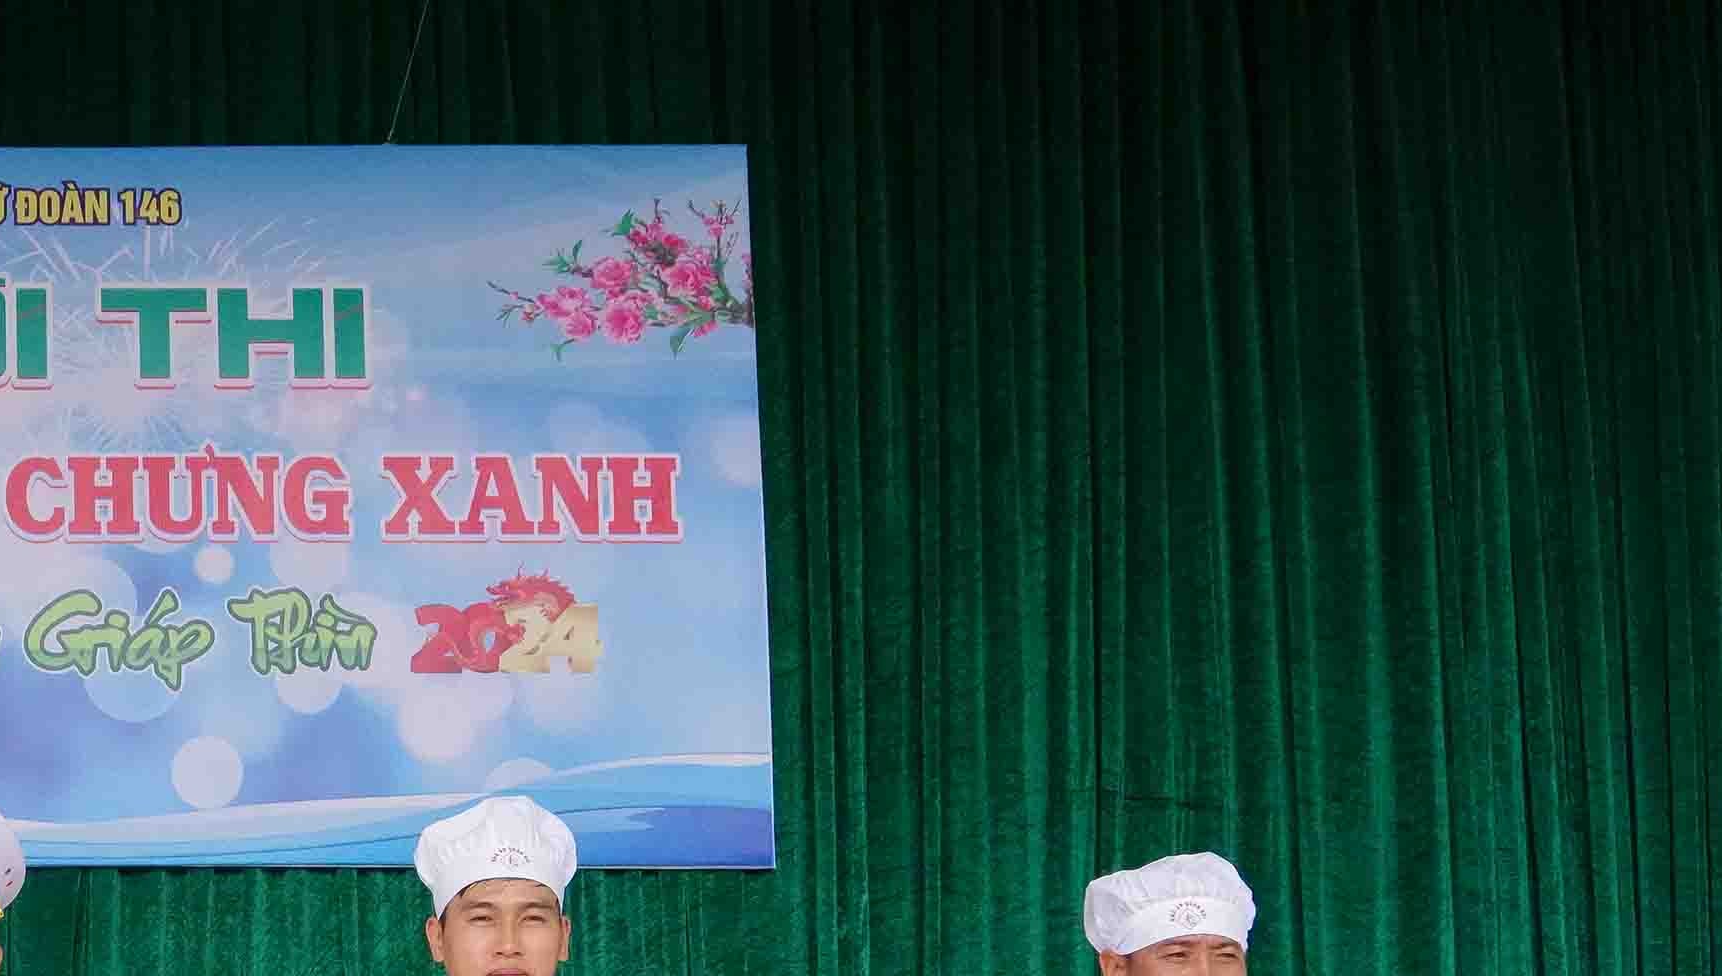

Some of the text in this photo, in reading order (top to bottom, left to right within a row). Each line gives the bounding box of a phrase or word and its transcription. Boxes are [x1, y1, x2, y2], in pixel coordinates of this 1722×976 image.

[14, 180, 110, 225] ĐOÀN
[118, 187, 182, 225] 146
[97, 286, 369, 387] THI
[5, 442, 350, 540] CHƯNG
[381, 455, 680, 540] XANH
[23, 588, 215, 690] Giáp
[226, 586, 377, 676] Thìn
[411, 601, 603, 674] 2024
